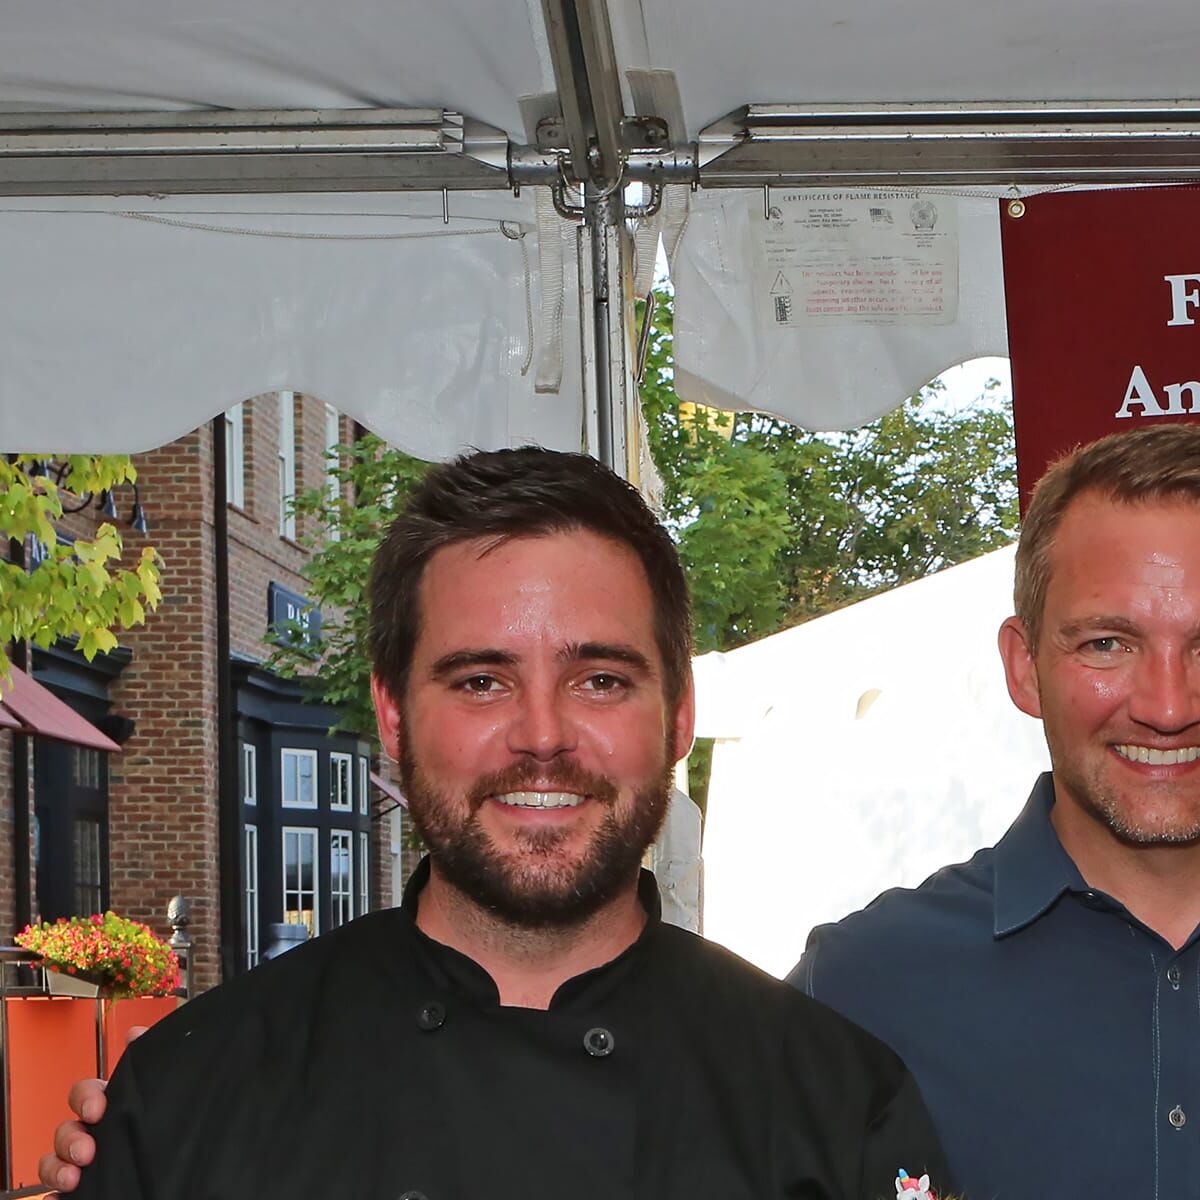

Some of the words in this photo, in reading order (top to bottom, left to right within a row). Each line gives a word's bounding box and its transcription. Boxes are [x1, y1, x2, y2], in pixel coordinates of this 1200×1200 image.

[783, 193, 830, 202] CERTIFICATE
[833, 193, 842, 201] OF
[845, 193, 871, 201] FLAME
[873, 192, 919, 200] RESISTANCE
